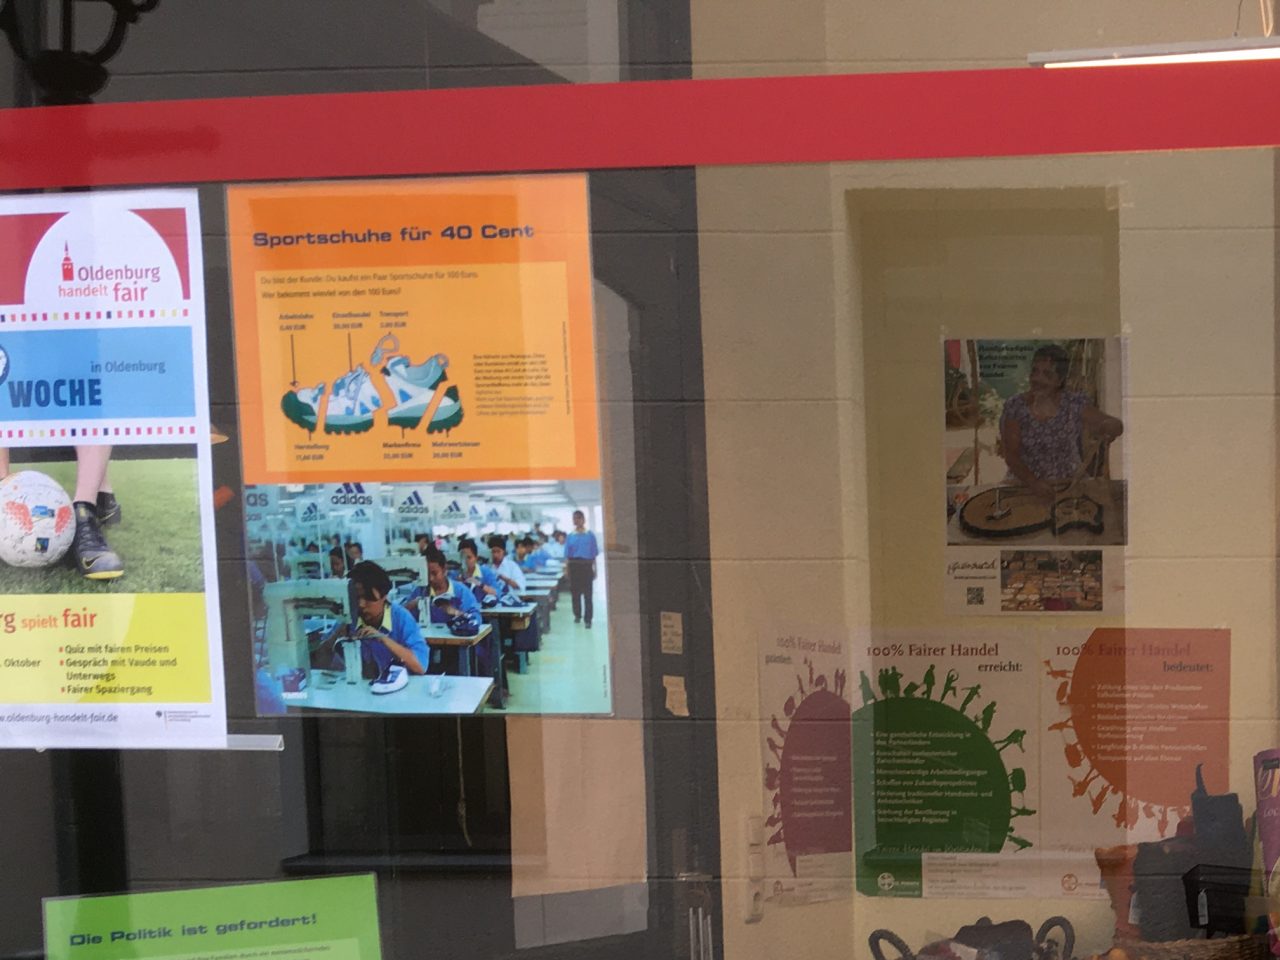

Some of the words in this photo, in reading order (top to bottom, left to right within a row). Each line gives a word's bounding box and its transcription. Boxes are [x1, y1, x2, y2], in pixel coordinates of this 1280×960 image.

[253, 230, 391, 249] Sportschuhe
[401, 227, 432, 241] für
[441, 226, 472, 239] 40
[482, 225, 534, 238] Cent
[78, 265, 160, 282] Oldenburg
[58, 285, 108, 297] handelt
[113, 281, 148, 302] fair
[91, 361, 101, 373] in
[105, 361, 166, 374] Oldenburg
[8, 379, 102, 407] WOCHE
[331, 493, 372, 505] adidas
[399, 506, 428, 514] adidas
[21, 614, 58, 630] spielt
[63, 608, 97, 628] fair
[65, 645, 84, 654] Quiz
[88, 645, 102, 653] mit
[105, 644, 132, 653] fairen
[135, 645, 169, 653] Preisen
[908, 644, 947, 656] Fairer
[951, 643, 999, 657] Handel
[4, 659, 41, 667] Oktober
[66, 658, 108, 668] Gespräch
[111, 658, 125, 666] mit
[128, 658, 157, 666] Vaude
[160, 658, 177, 666] und
[66, 671, 115, 681] Unterwegs
[67, 685, 93, 694] Fairer
[96, 686, 152, 696] Spaziergang
[70, 933, 102, 946] Die
[111, 927, 173, 942] Politik
[182, 925, 208, 936] ist
[216, 913, 317, 935] gefordert!
